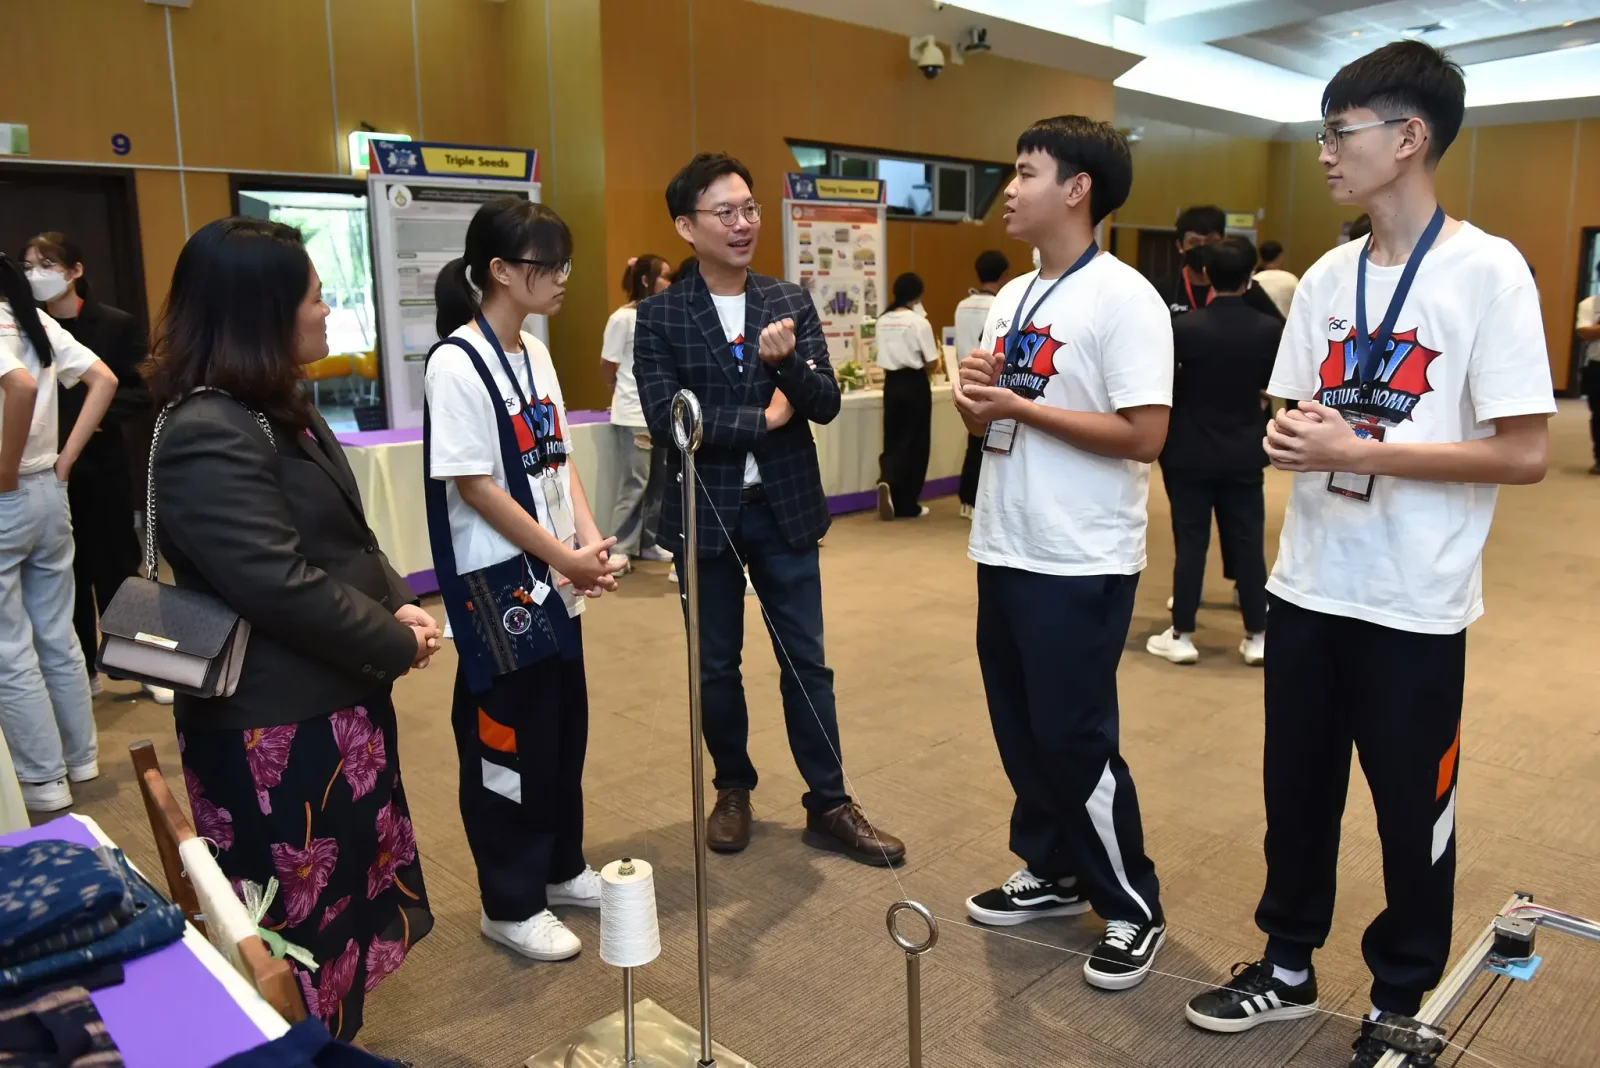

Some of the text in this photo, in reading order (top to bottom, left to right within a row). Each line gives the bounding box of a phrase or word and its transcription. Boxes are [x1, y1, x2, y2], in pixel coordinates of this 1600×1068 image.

[111, 132, 131, 156] 9
[445, 154, 509, 168] Triple Seeds
[1323, 388, 1416, 413] RETUR HOME
